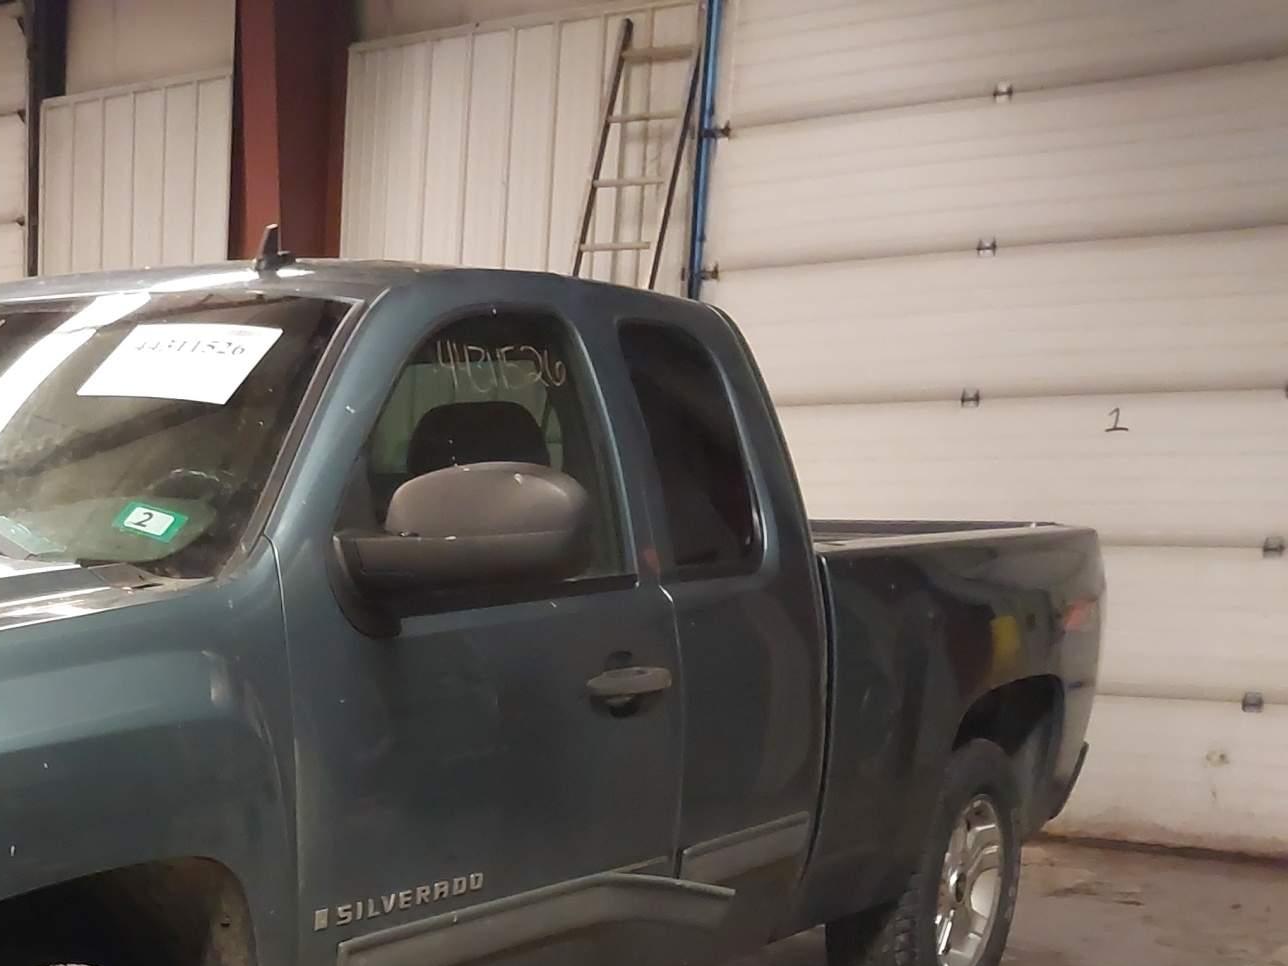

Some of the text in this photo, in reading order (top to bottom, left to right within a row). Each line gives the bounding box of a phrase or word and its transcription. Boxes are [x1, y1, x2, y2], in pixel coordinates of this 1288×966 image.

[1105, 407, 1129, 433] 1
[130, 511, 154, 528] 2
[336, 872, 484, 927] SILVERADO
